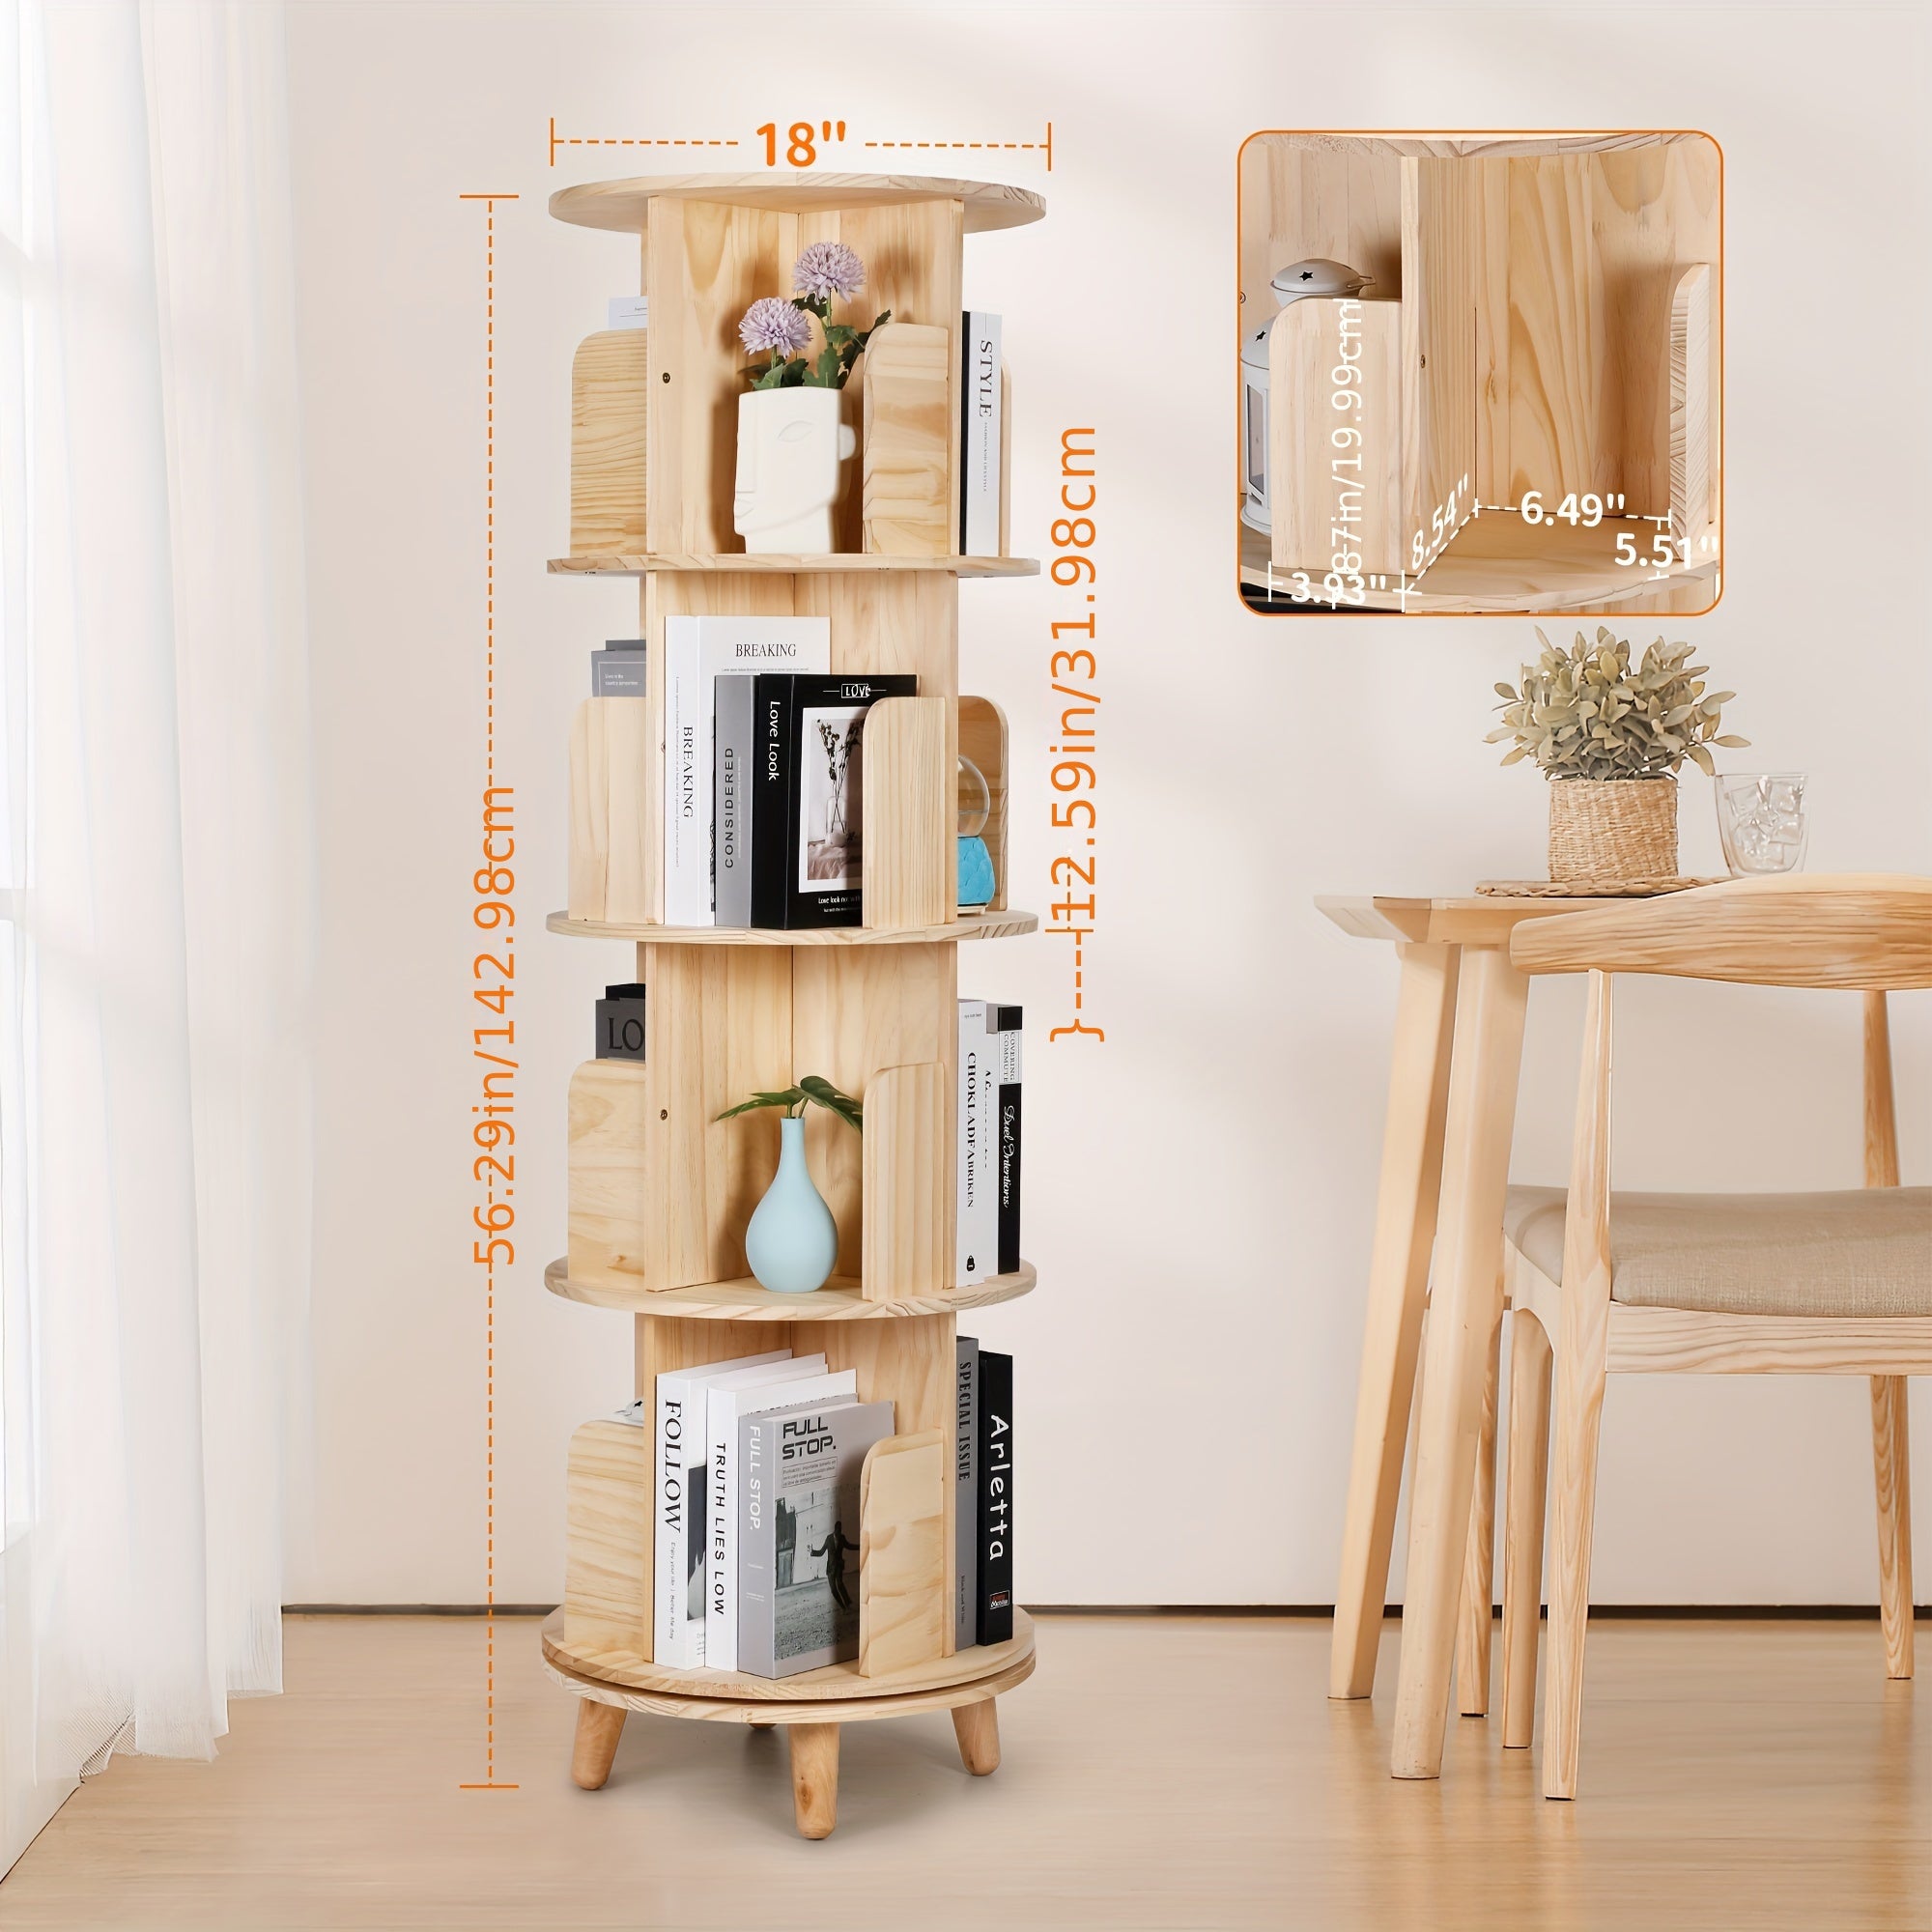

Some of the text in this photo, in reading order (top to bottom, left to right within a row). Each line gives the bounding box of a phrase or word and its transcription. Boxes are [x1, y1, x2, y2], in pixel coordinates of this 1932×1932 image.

[980, 340, 993, 417] STYLE
[735, 643, 797, 658] BREAKING
[682, 726, 694, 818] BREAKING
[768, 700, 781, 781] Love Look
[724, 748, 734, 868] CONSIDERED
[608, 1017, 644, 1052] LO
[967, 1051, 977, 1208] CHOKLADFABRIKEN
[665, 1400, 682, 1533] FOLLOW
[781, 1435, 837, 1461] STOP.
[782, 1416, 829, 1439] FULL
[958, 1361, 972, 1481] SPECIAL ISSUE
[748, 1425, 761, 1531] FULL STOP.
[989, 1414, 1011, 1561] Arletta
[713, 1442, 726, 1615] TRUTH LIES LOW
